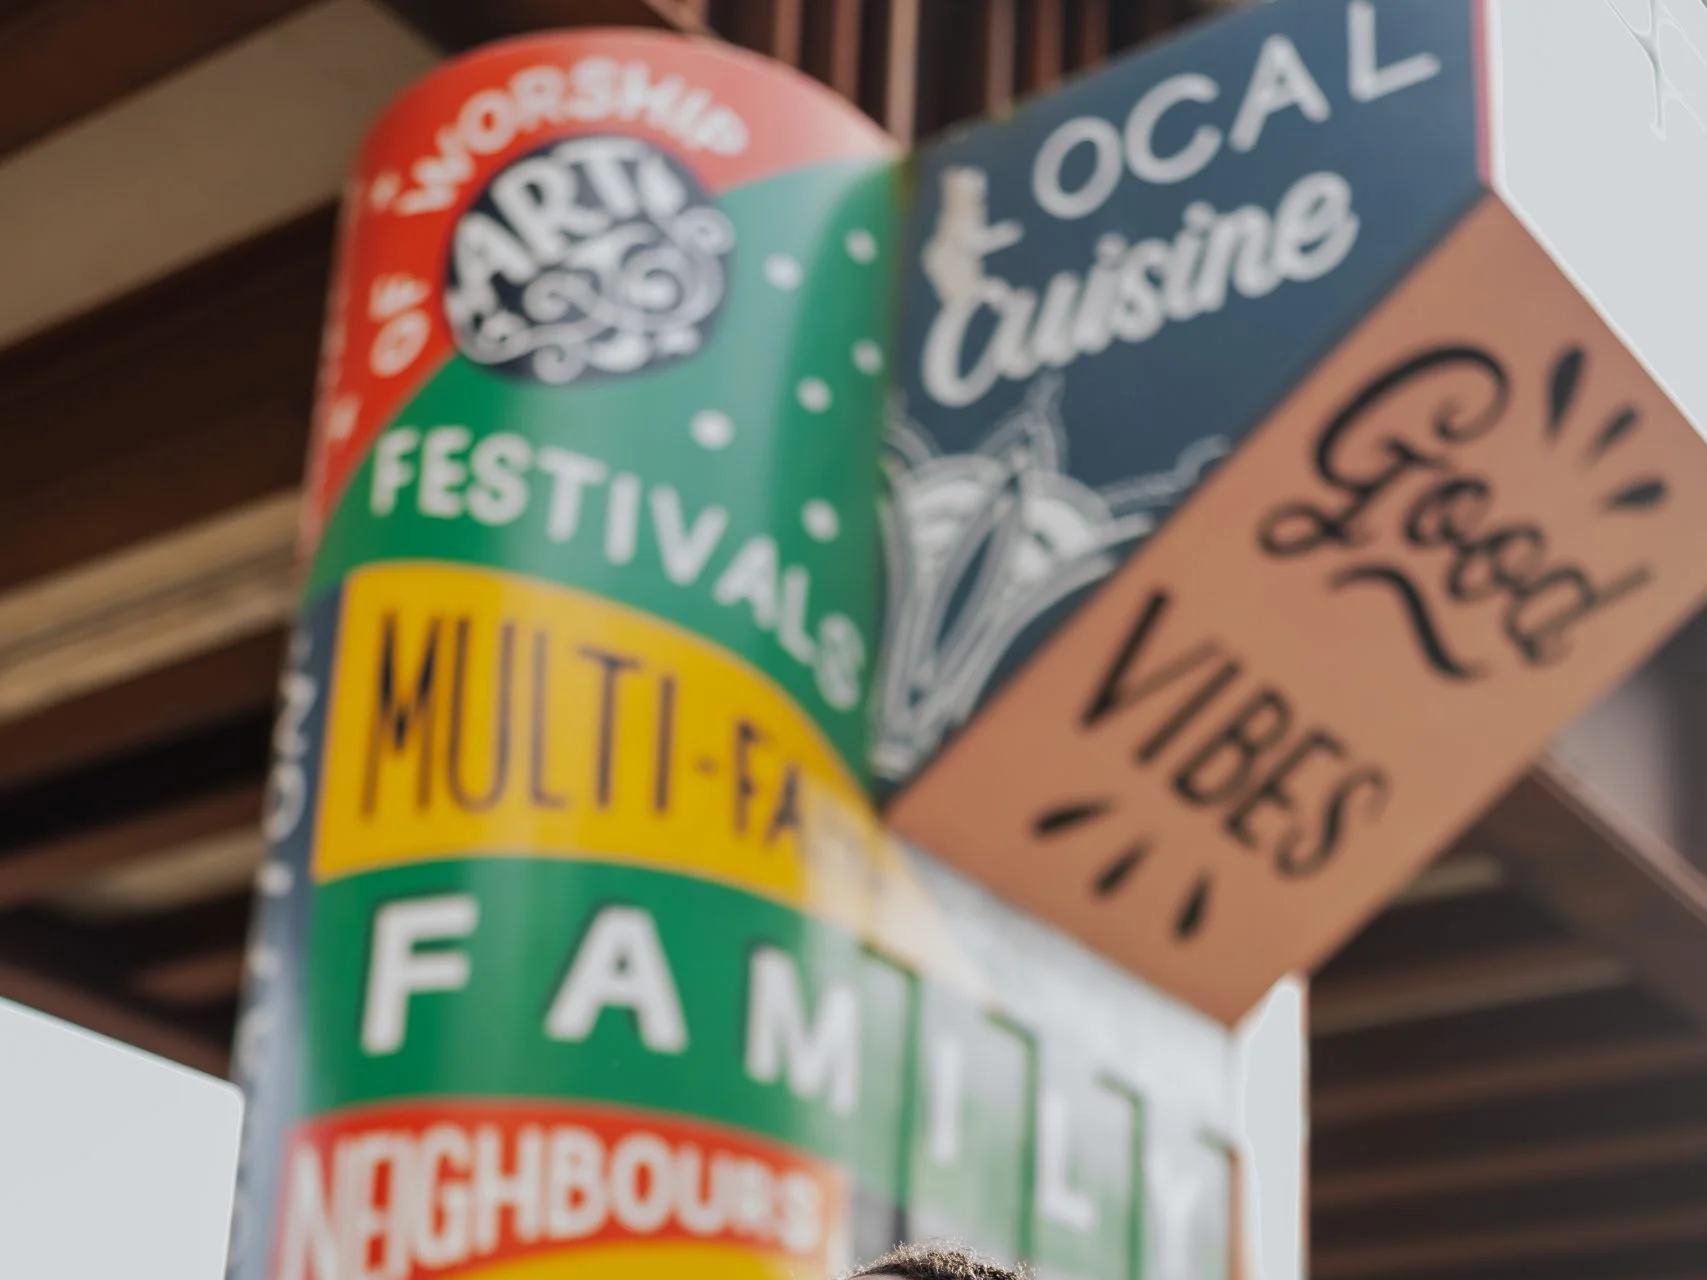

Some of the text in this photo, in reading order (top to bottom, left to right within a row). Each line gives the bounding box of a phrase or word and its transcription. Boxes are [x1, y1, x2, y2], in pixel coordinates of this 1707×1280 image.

[398, 55, 748, 217] WORSHIP
[938, 0, 1440, 256] LOCAL
[369, 424, 868, 712] FESTIVALS
[1256, 343, 1657, 667] Good
[1078, 588, 1391, 881] VIBES
